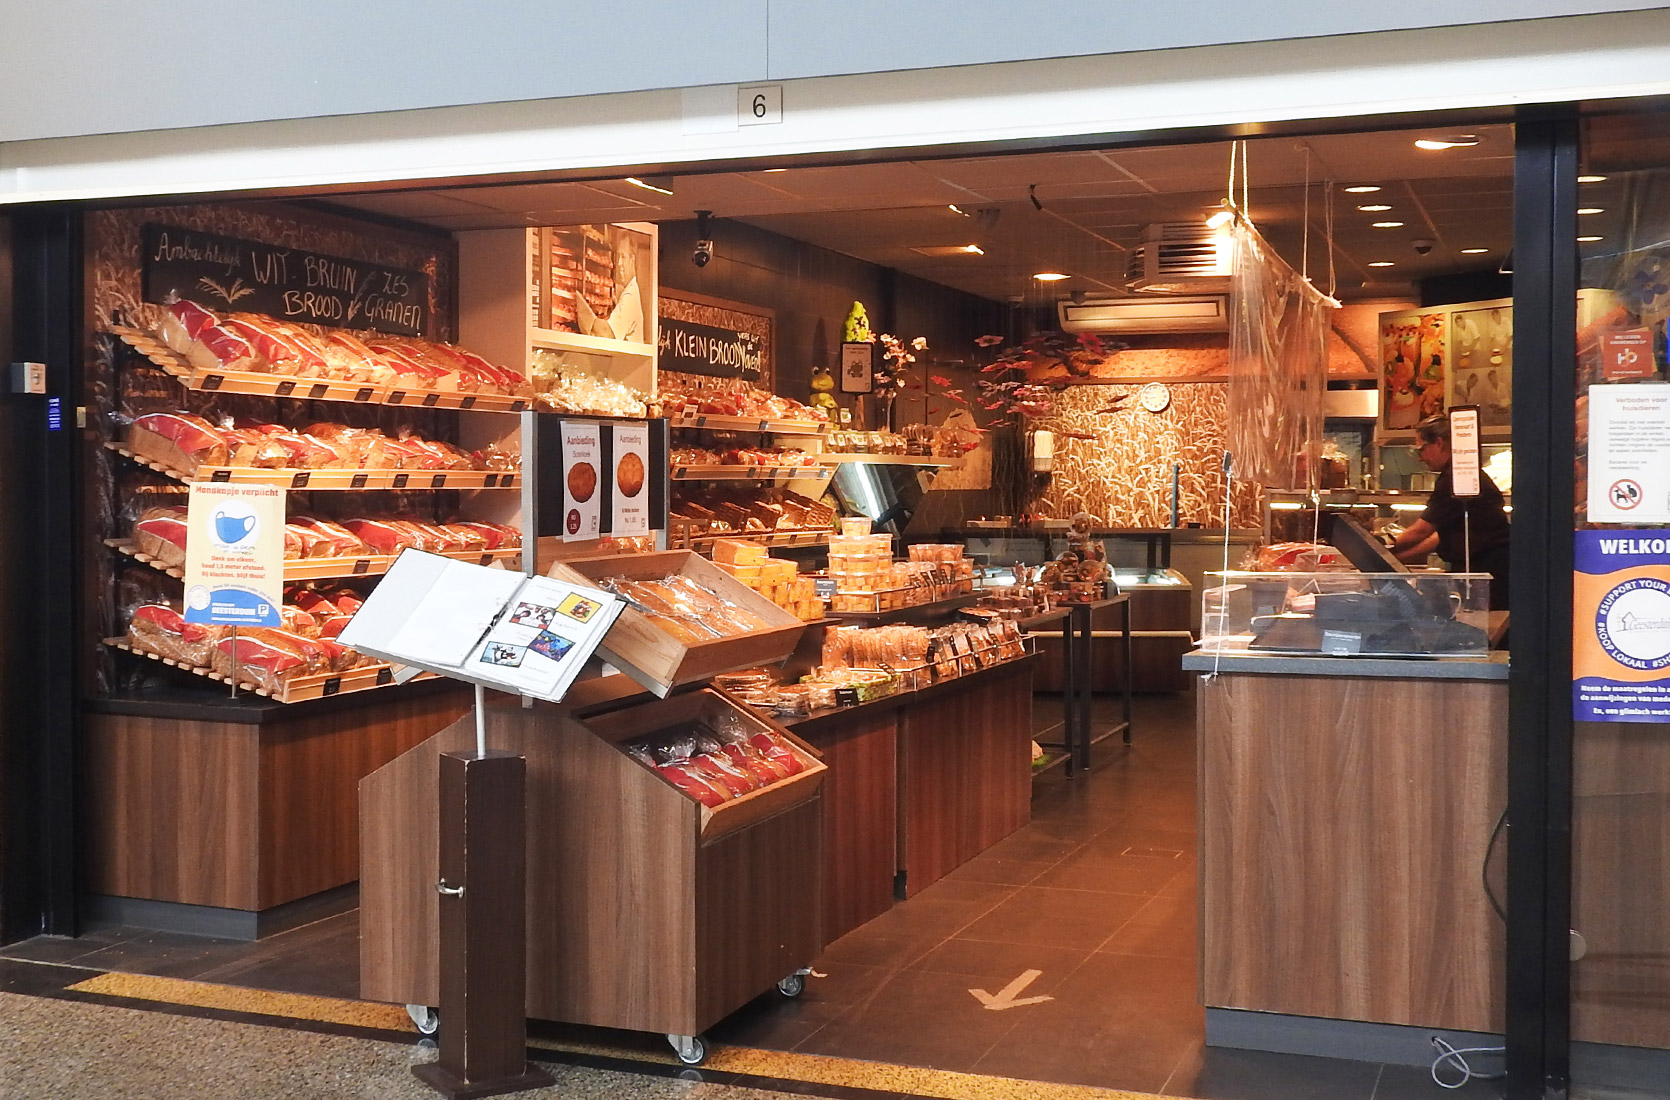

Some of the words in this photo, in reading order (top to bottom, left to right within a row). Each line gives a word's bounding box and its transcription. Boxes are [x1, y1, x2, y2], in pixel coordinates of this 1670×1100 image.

[752, 94, 766, 118] 6
[252, 251, 290, 285] WIT
[304, 256, 357, 294] BRUIN
[382, 271, 409, 297] ZES
[282, 290, 342, 320] BROOD
[364, 293, 421, 330] GRANEN
[675, 328, 707, 359] KLEIN
[241, 488, 279, 497] verplicht
[1599, 538, 1670, 555] WELKO
[1638, 579, 1667, 592] YOUR
[1611, 649, 1648, 669] LOKAAL
[1590, 694, 1637, 702] aanwijzingen
[1612, 685, 1657, 694] maatregelen
[1619, 707, 1650, 716] glimlach
